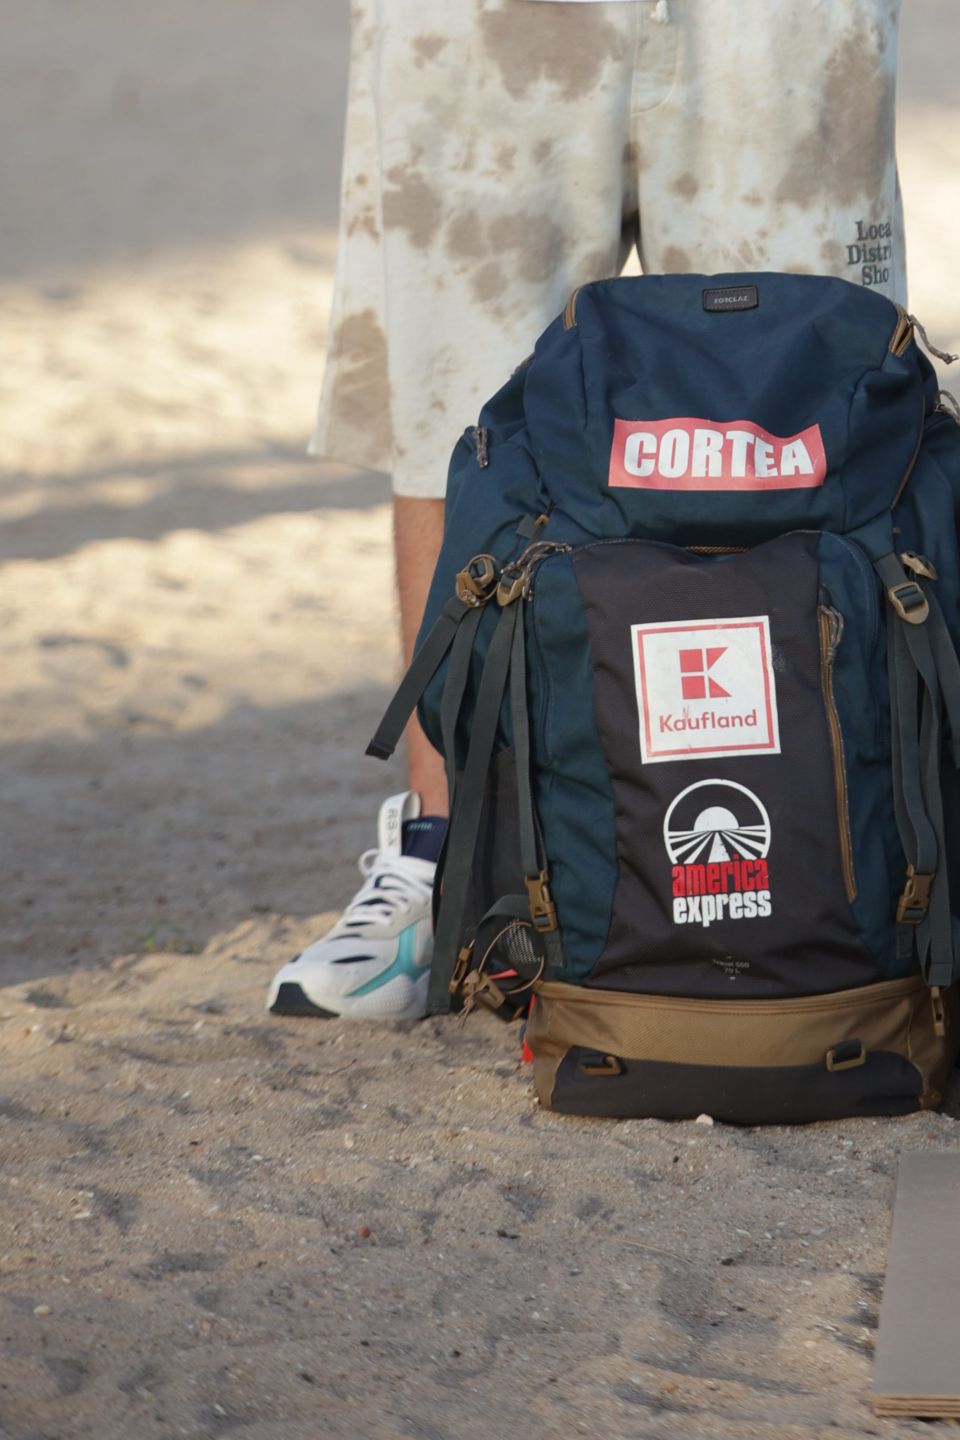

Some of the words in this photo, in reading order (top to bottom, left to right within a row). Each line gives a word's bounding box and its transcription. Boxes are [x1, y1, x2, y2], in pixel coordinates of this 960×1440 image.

[623, 428, 815, 479] CORTEA
[659, 708, 757, 733] Kaufland
[671, 853, 769, 897] america
[672, 889, 772, 928] express
